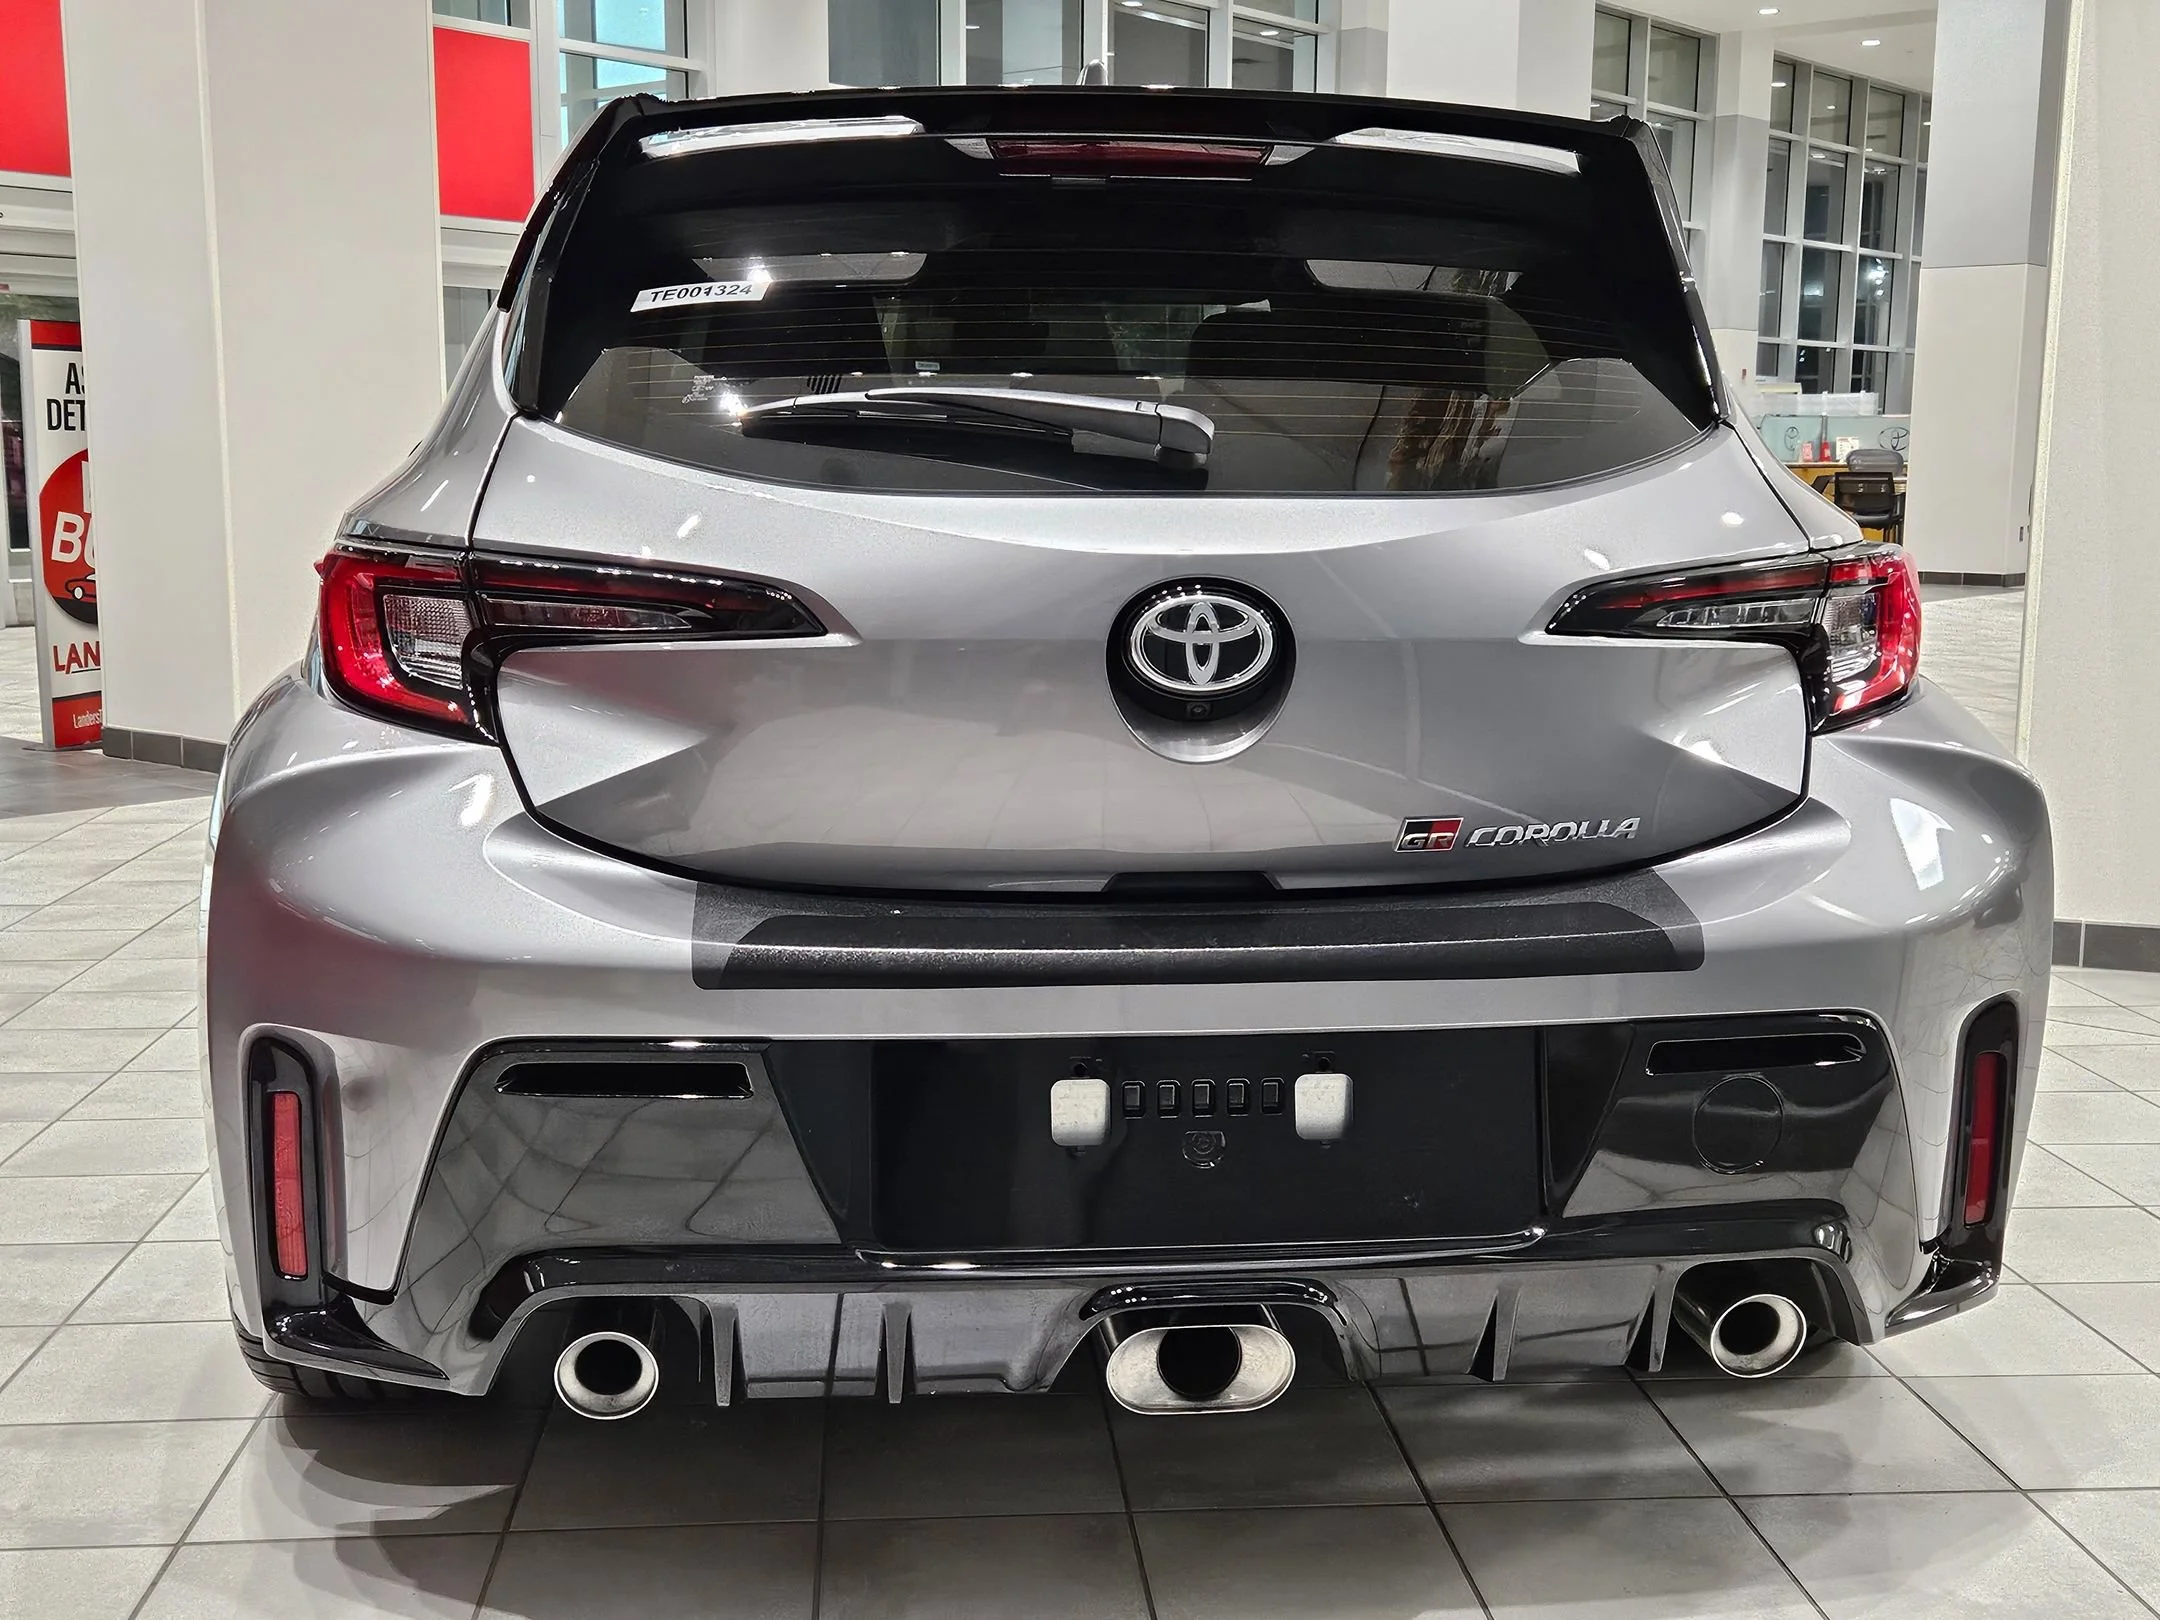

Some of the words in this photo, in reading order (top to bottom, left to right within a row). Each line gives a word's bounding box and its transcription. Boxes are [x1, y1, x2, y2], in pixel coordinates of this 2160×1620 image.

[651, 284, 753, 302] TE001324
[53, 641, 100, 674] LAN
[1401, 832, 1454, 849] GR
[1465, 817, 1641, 847] COROLLA
